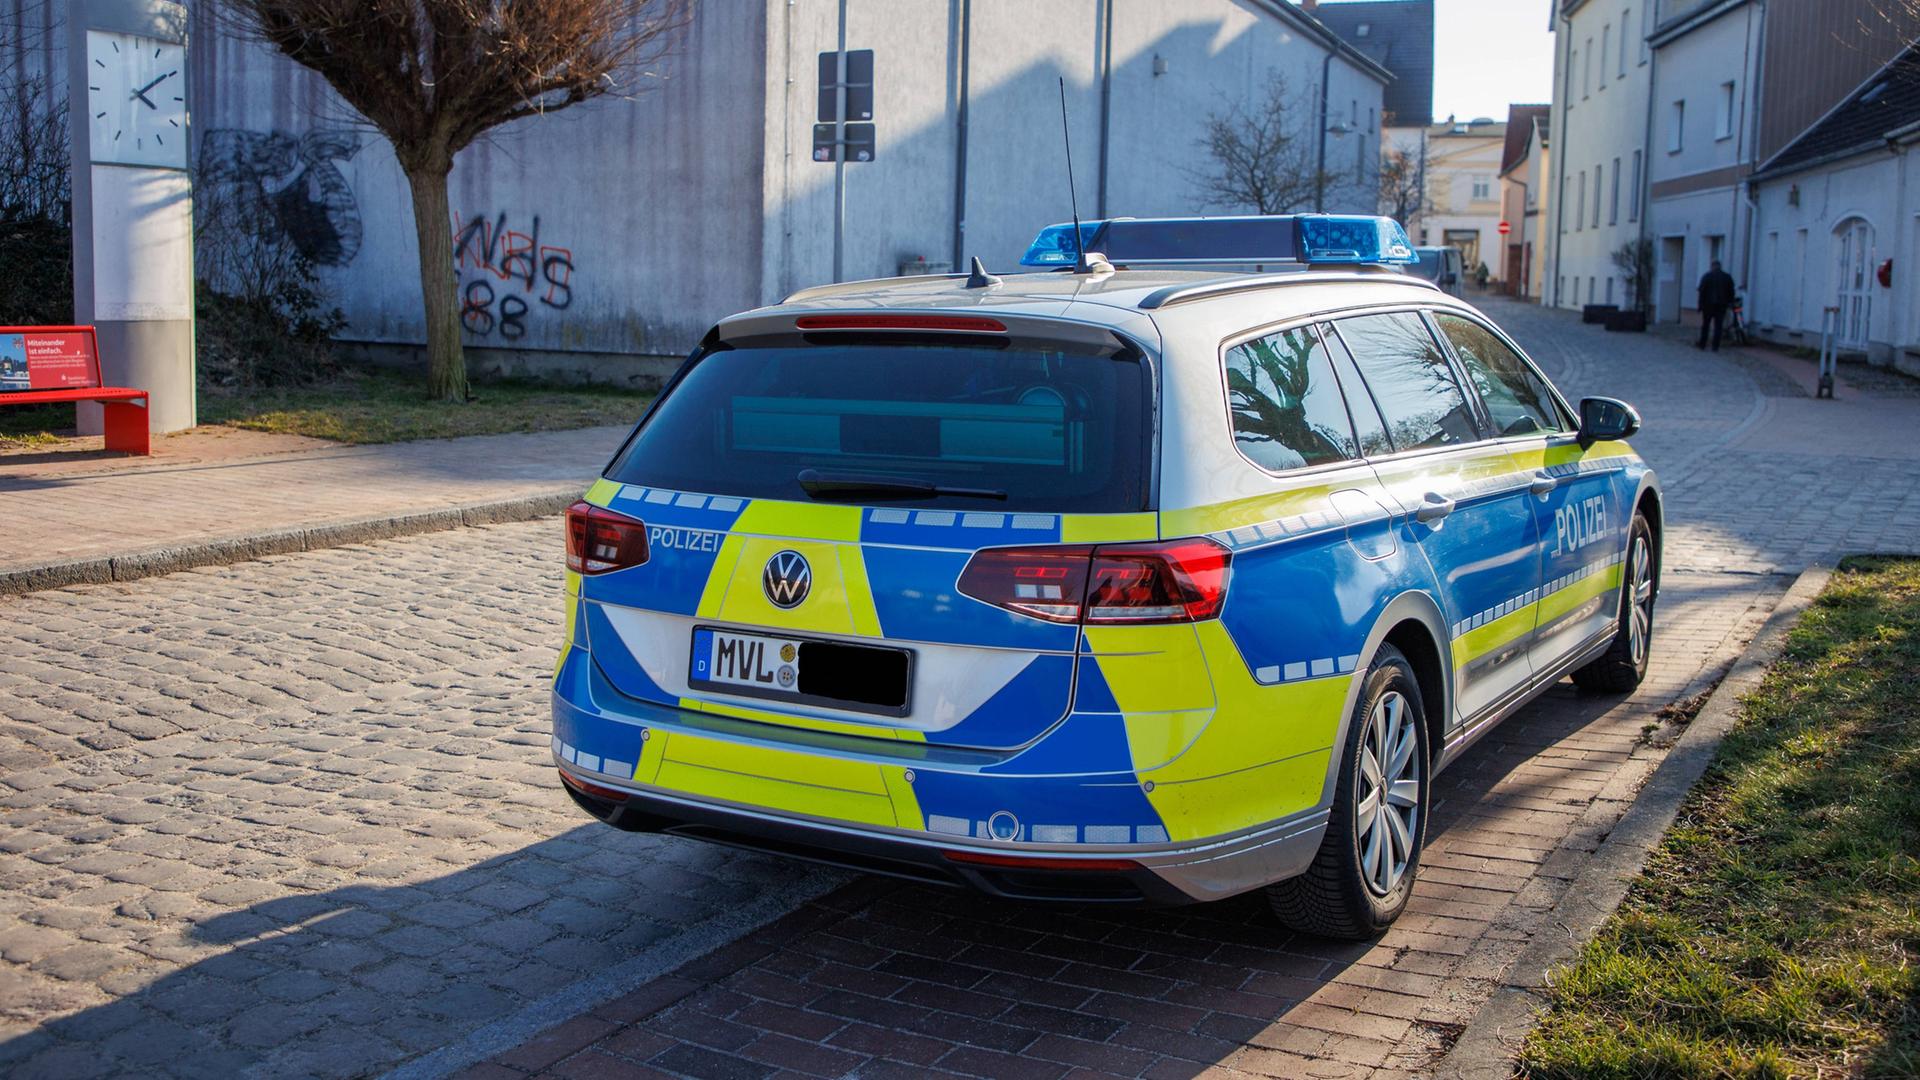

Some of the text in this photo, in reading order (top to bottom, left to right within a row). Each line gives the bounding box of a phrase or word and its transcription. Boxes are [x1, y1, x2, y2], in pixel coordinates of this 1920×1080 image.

[461, 279, 528, 340] 88
[650, 527, 718, 553] POLIZEI
[1553, 494, 1607, 557] POLIZEI
[698, 637, 774, 683] D MVL
